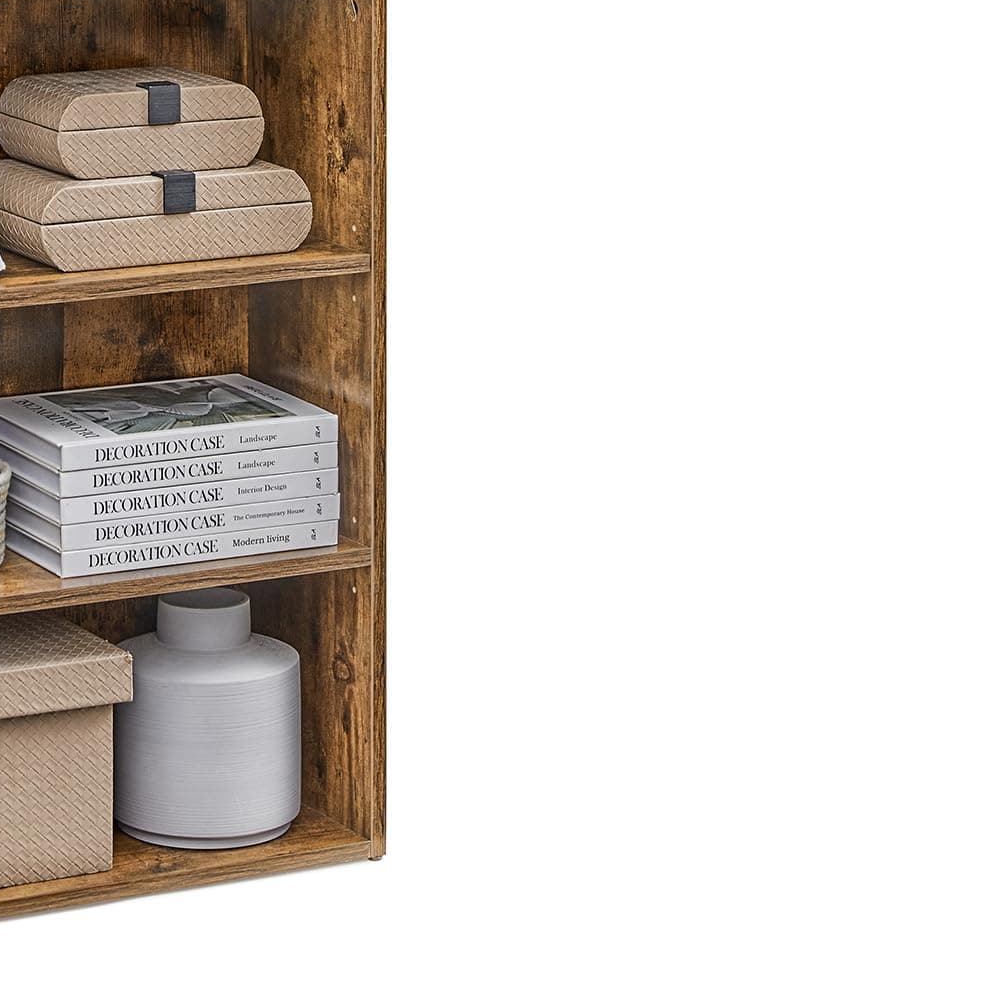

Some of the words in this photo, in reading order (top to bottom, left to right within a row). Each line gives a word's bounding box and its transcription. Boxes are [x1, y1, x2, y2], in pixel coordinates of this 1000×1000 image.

[95, 438, 188, 462] DECORATION
[190, 435, 225, 452] CASE
[240, 434, 278, 444] Landscape
[93, 464, 186, 488] DECORATION
[188, 460, 224, 478] CASE
[238, 460, 276, 470] Landscape
[93, 491, 186, 515] DECORATION
[189, 487, 224, 504] CASE
[238, 486, 262, 495] Interior
[264, 484, 288, 492] Design
[96, 517, 188, 541] DECORATION
[191, 513, 226, 530] CASE
[245, 510, 286, 520] Contemporary
[89, 544, 182, 568] DECORATION
[184, 539, 219, 556] CASE
[232, 536, 265, 548] Modern
[266, 534, 290, 544] living
